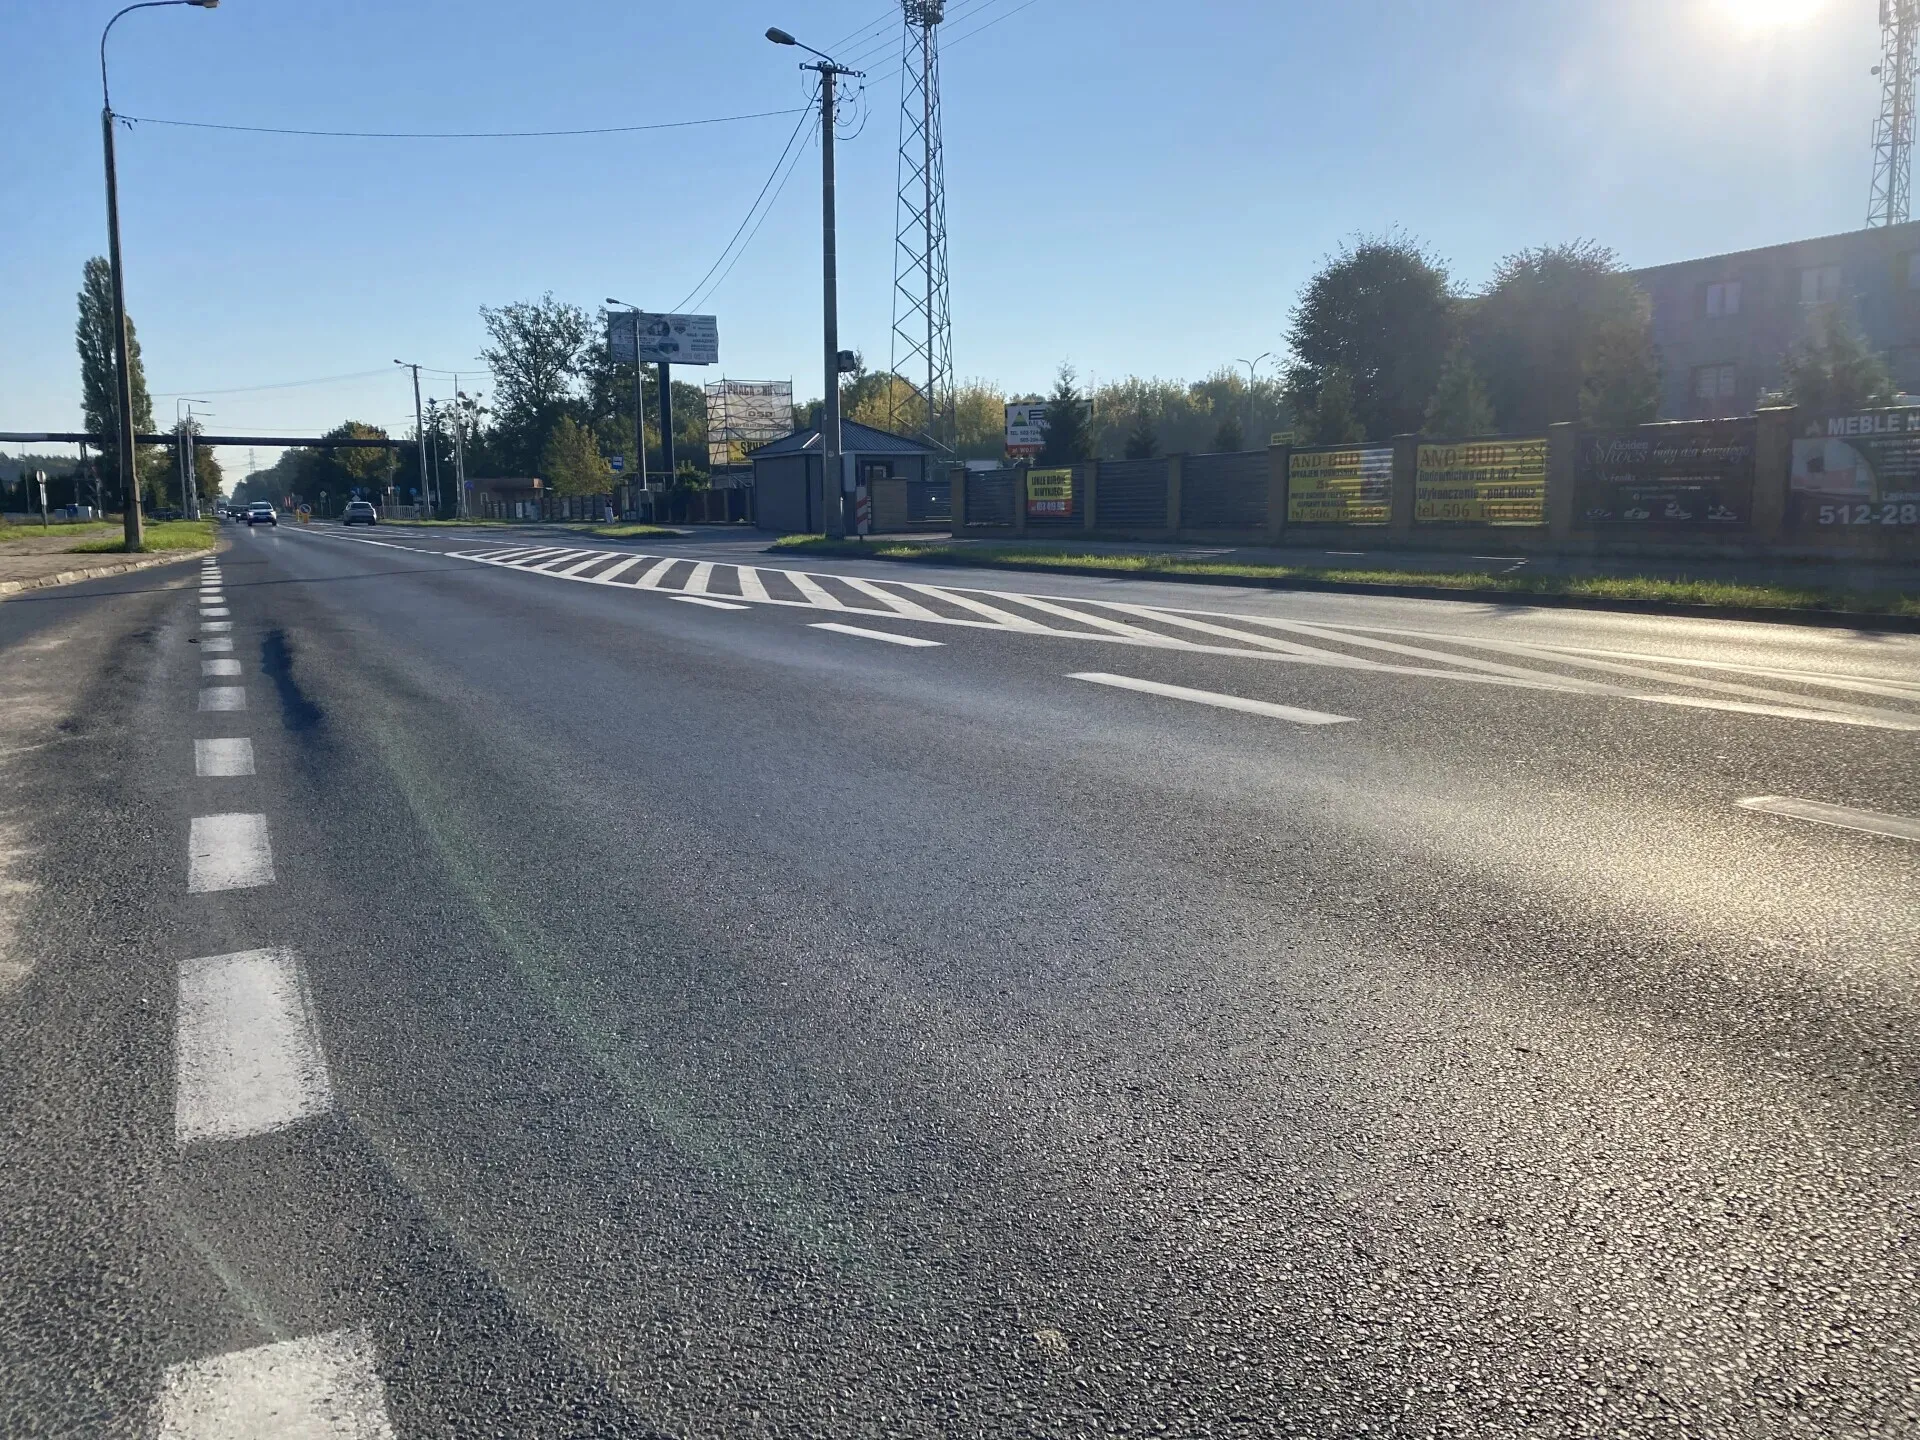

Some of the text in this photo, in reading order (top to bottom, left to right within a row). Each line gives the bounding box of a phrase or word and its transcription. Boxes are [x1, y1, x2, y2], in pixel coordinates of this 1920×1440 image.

[1827, 414, 1901, 435] MEBLE
[1291, 453, 1360, 468] AND-BUD
[1421, 446, 1505, 467] AND-BUD
[1442, 503, 1470, 518] 506
[1818, 503, 1918, 525] 512-28
